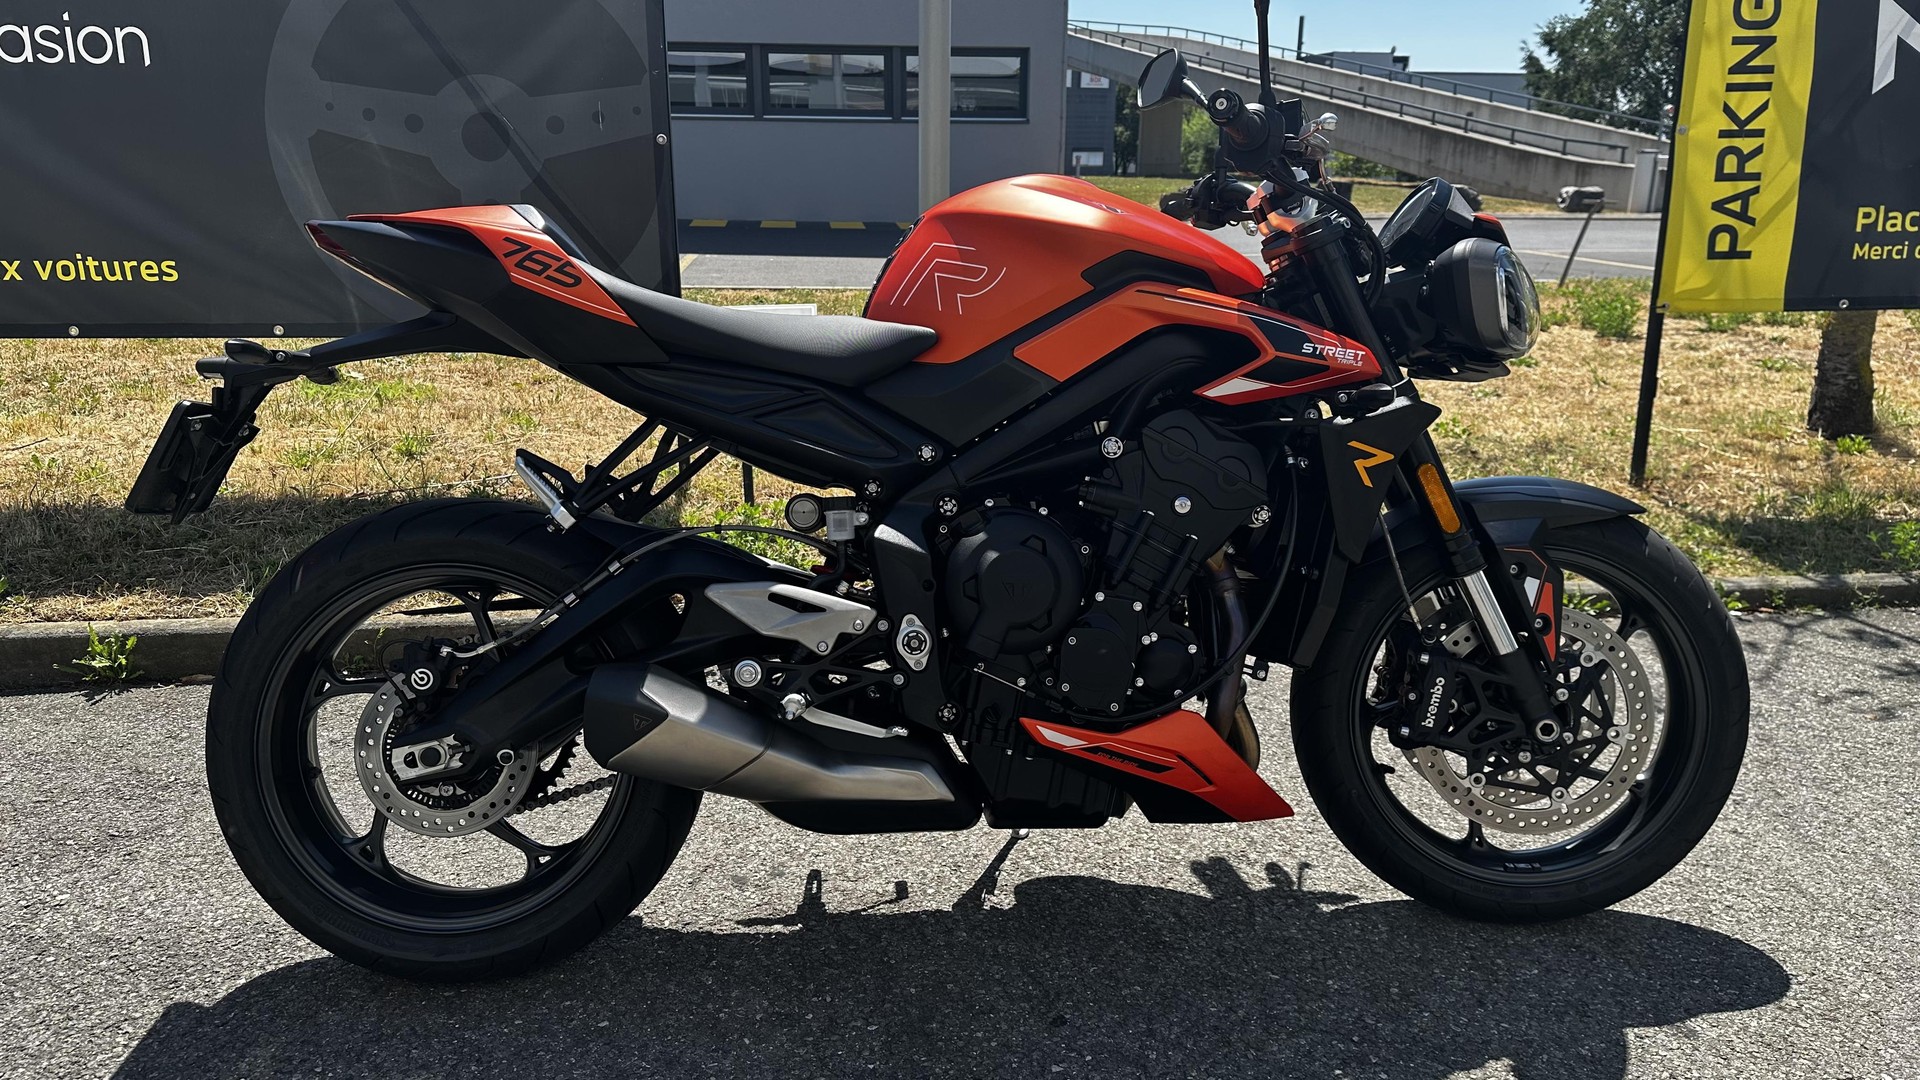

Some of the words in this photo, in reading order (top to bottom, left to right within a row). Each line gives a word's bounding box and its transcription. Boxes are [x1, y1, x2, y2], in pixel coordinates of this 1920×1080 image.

[0, 11, 151, 67] asion
[1707, 0, 1782, 260] PARKING
[1856, 205, 1920, 232] Plac
[502, 236, 583, 288] 765
[1852, 241, 1909, 260] Merci
[33, 253, 179, 282] voitures
[1301, 342, 1366, 361] STREET
[1337, 358, 1363, 367] TRIPLE
[1421, 677, 1445, 728] brembo
